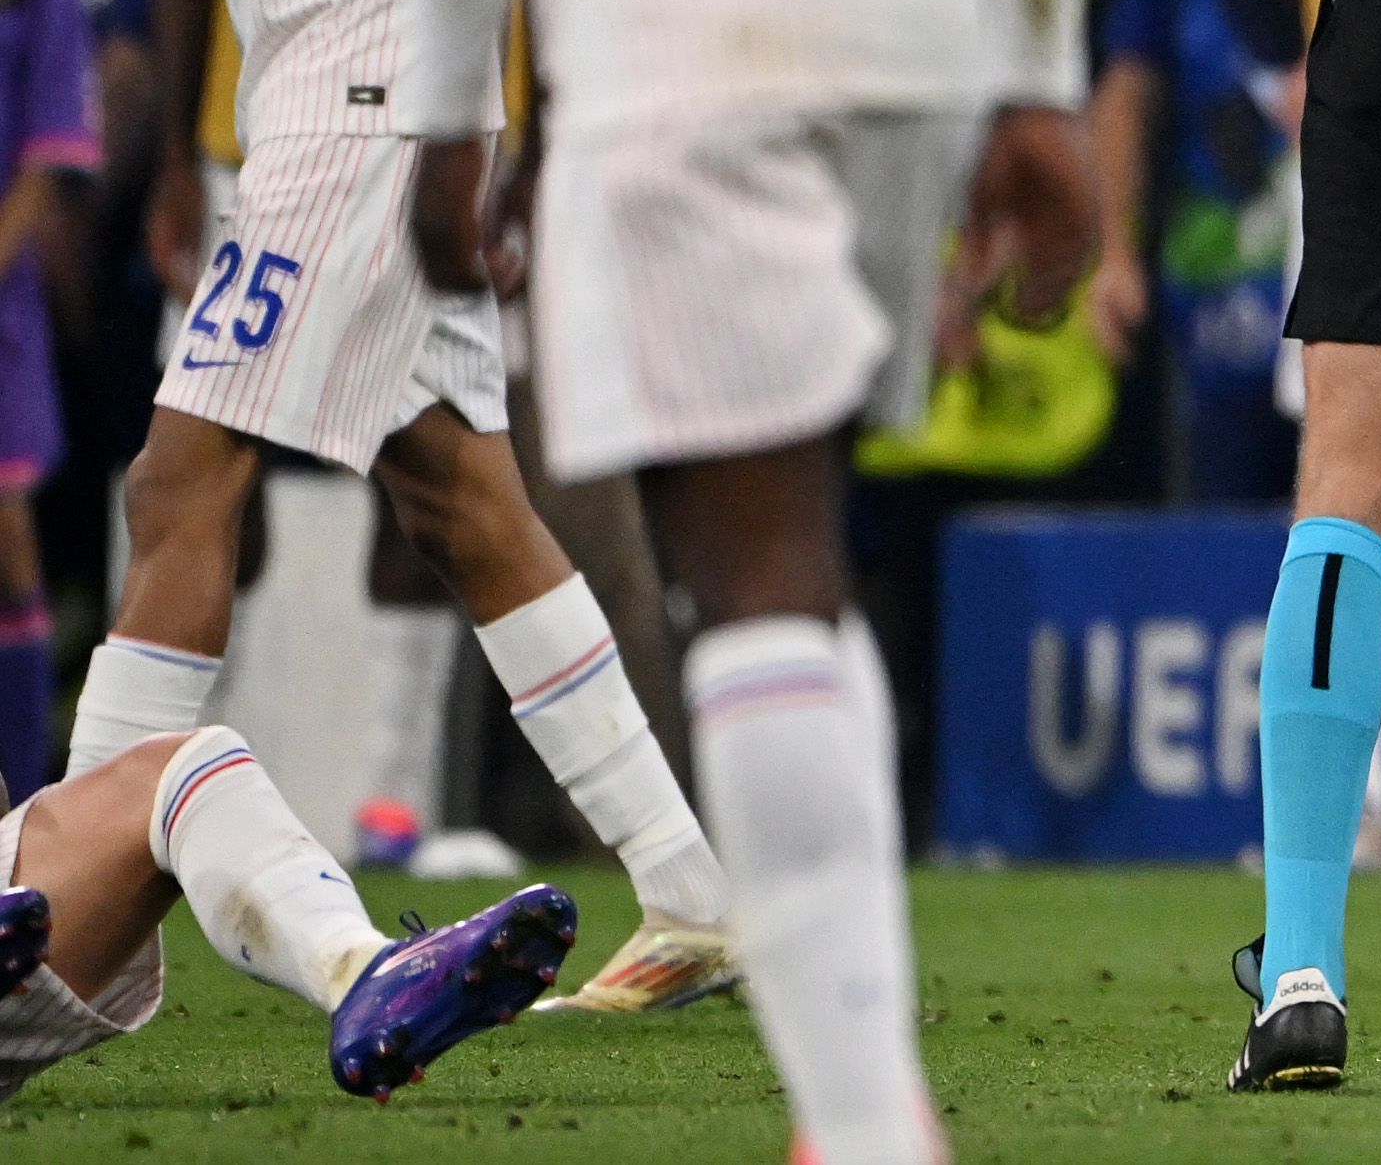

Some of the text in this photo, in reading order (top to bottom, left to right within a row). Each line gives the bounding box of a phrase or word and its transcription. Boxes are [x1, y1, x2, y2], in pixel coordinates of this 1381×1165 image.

[187, 239, 302, 352] 25
[1025, 618, 1264, 797] UEF
[1280, 980, 1326, 998] adidas
